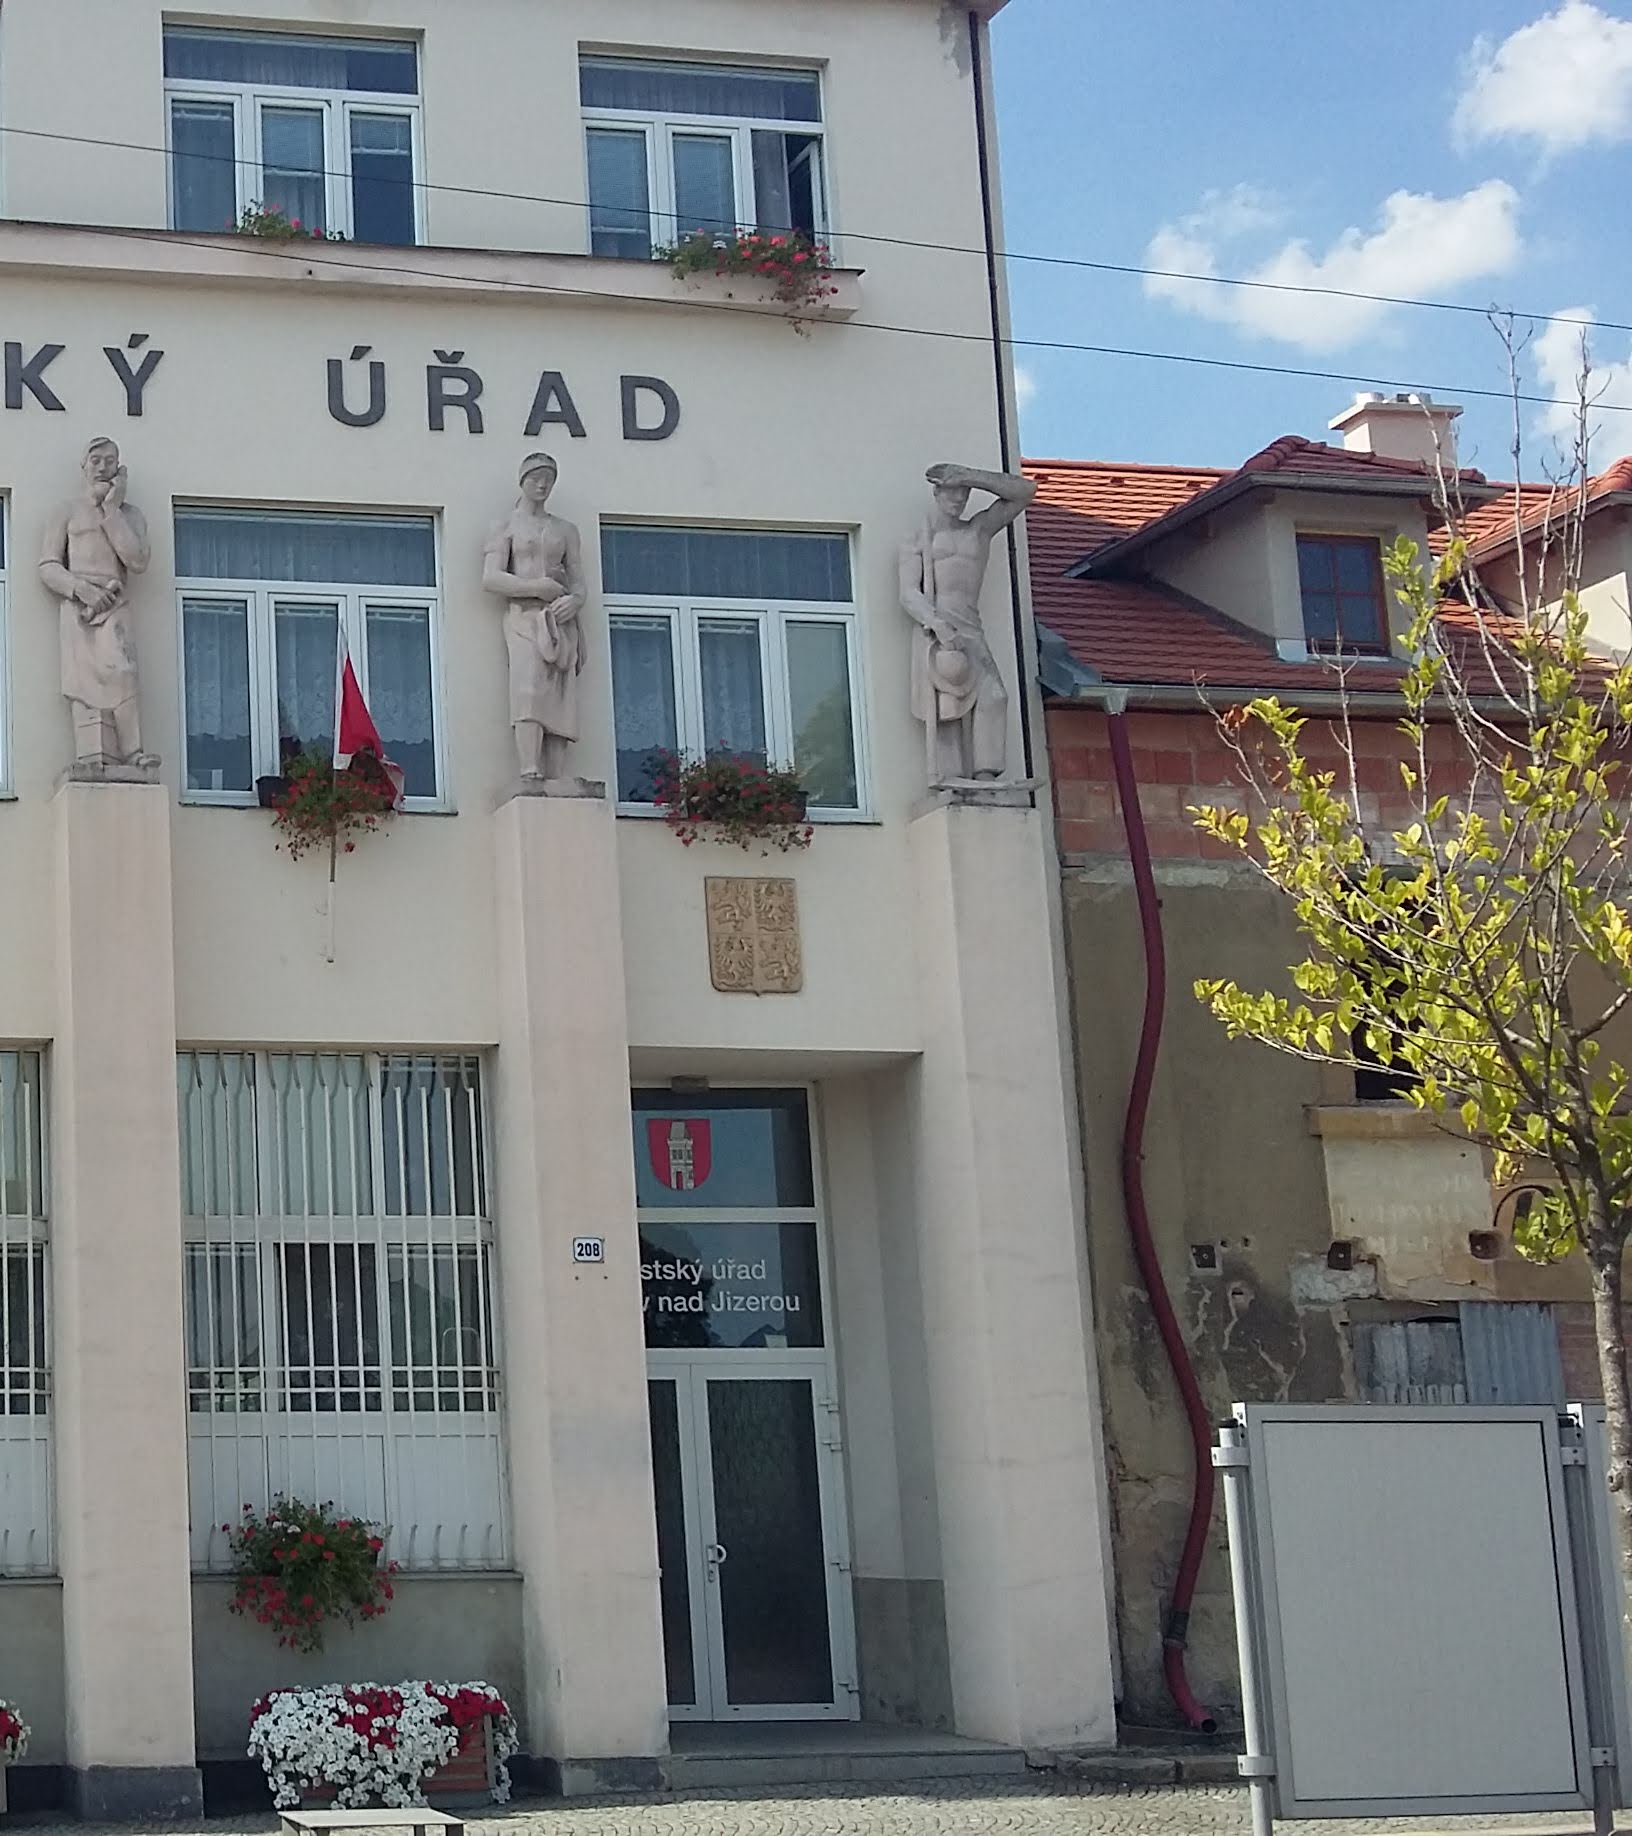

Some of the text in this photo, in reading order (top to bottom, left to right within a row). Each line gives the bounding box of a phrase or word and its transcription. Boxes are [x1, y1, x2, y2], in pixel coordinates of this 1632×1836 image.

[326, 345, 682, 441] ÚŘAD
[576, 1242, 600, 1257] 208
[711, 1258, 767, 1280] úřad
[658, 1290, 704, 1312] nad
[711, 1290, 801, 1312] Jizerou
